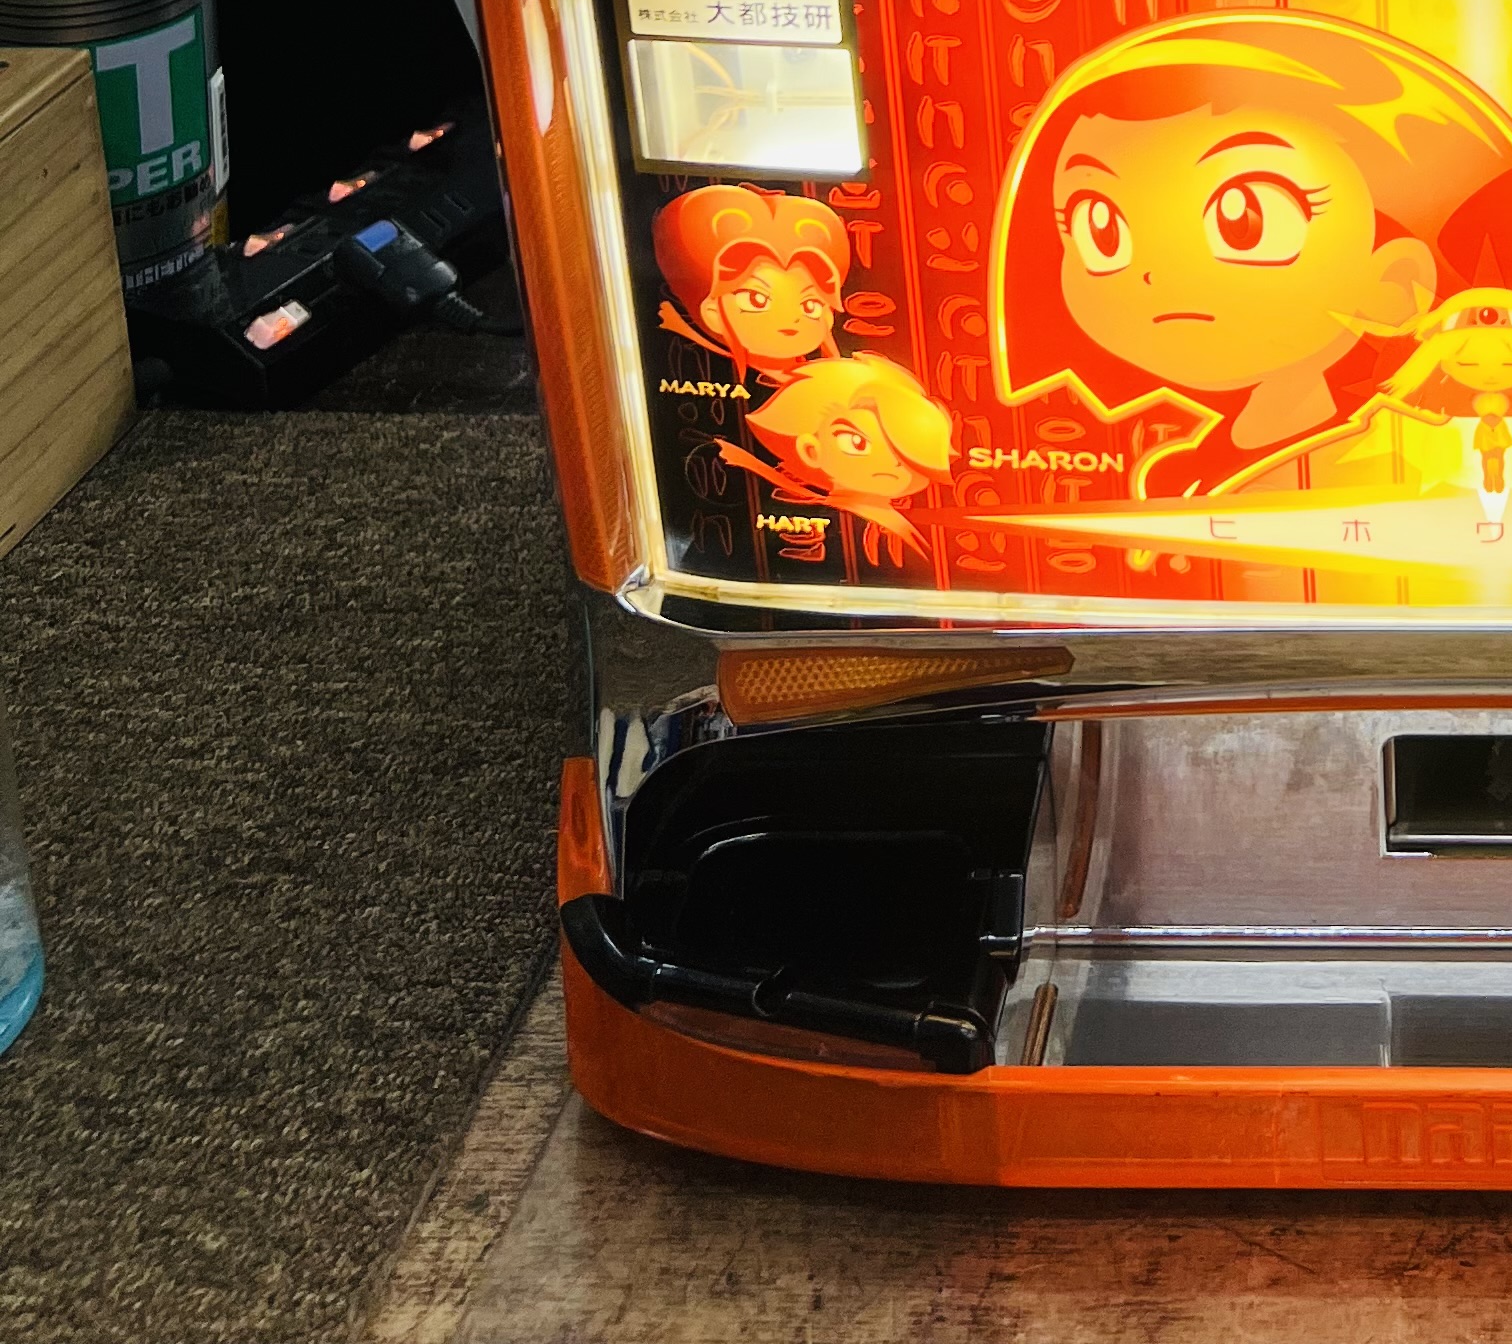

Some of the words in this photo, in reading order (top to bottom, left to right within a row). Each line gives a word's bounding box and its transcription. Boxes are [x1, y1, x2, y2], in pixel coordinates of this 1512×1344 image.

[638, 8, 699, 24] 株式会社
[706, 0, 833, 31] 大都技研
[660, 377, 752, 401] MARYA
[968, 447, 1124, 474] SHARON
[755, 513, 832, 534] HART
